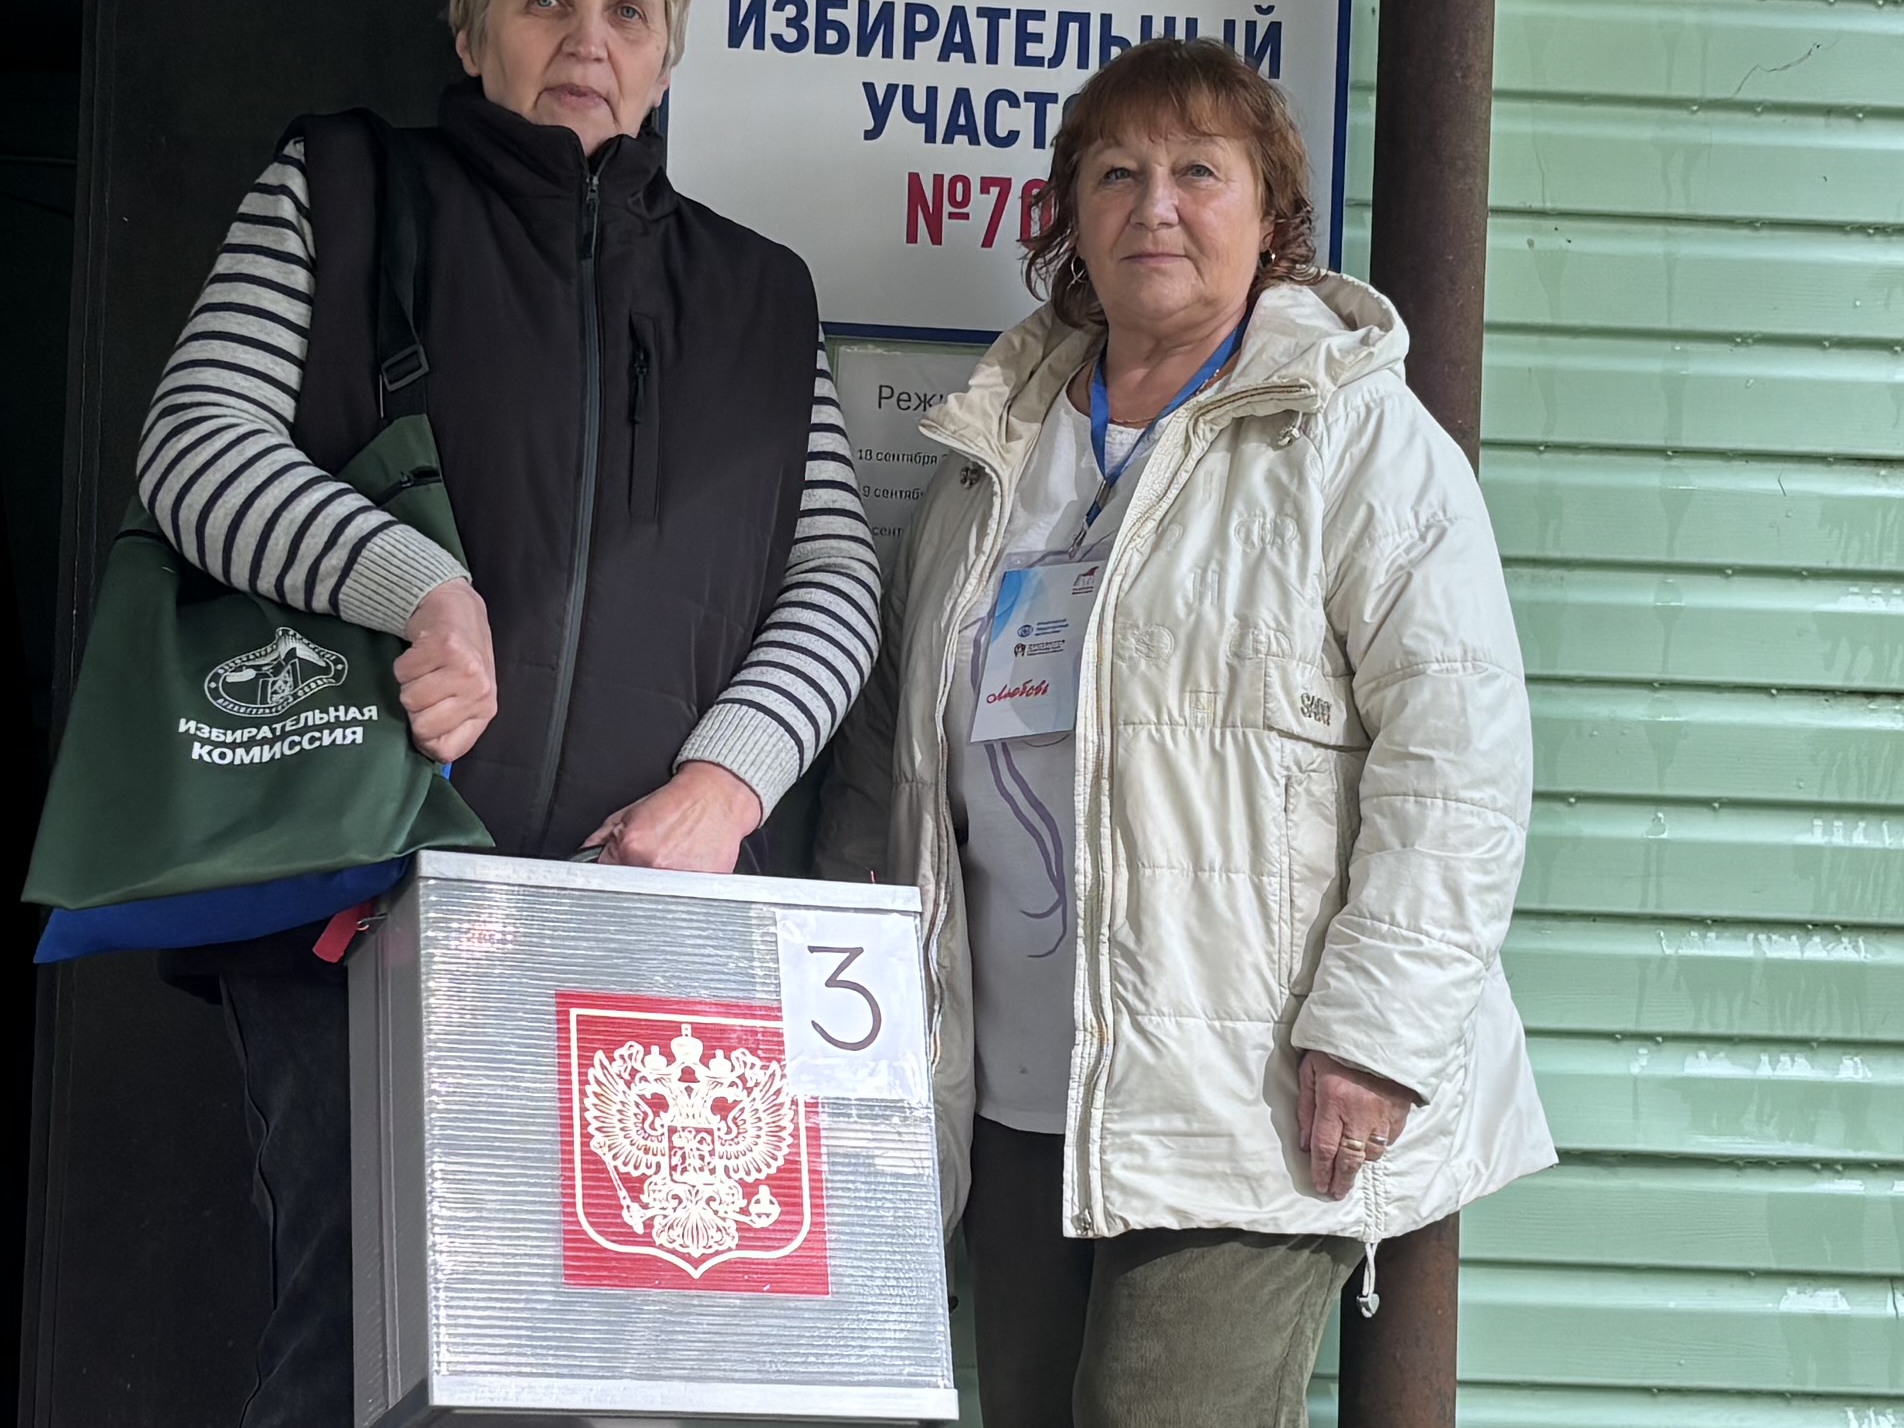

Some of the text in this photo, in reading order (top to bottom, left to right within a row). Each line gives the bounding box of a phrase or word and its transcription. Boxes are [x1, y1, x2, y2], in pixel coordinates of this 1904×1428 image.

[862, 81, 1080, 149] УЧАСТ
[878, 384, 944, 413] Реж
[873, 486, 924, 501] сентяб
[177, 704, 379, 744] ИЗБИРАТЕЛЬНАЯ
[191, 725, 364, 766] КОМИССИЯ
[807, 944, 883, 1052] 3
